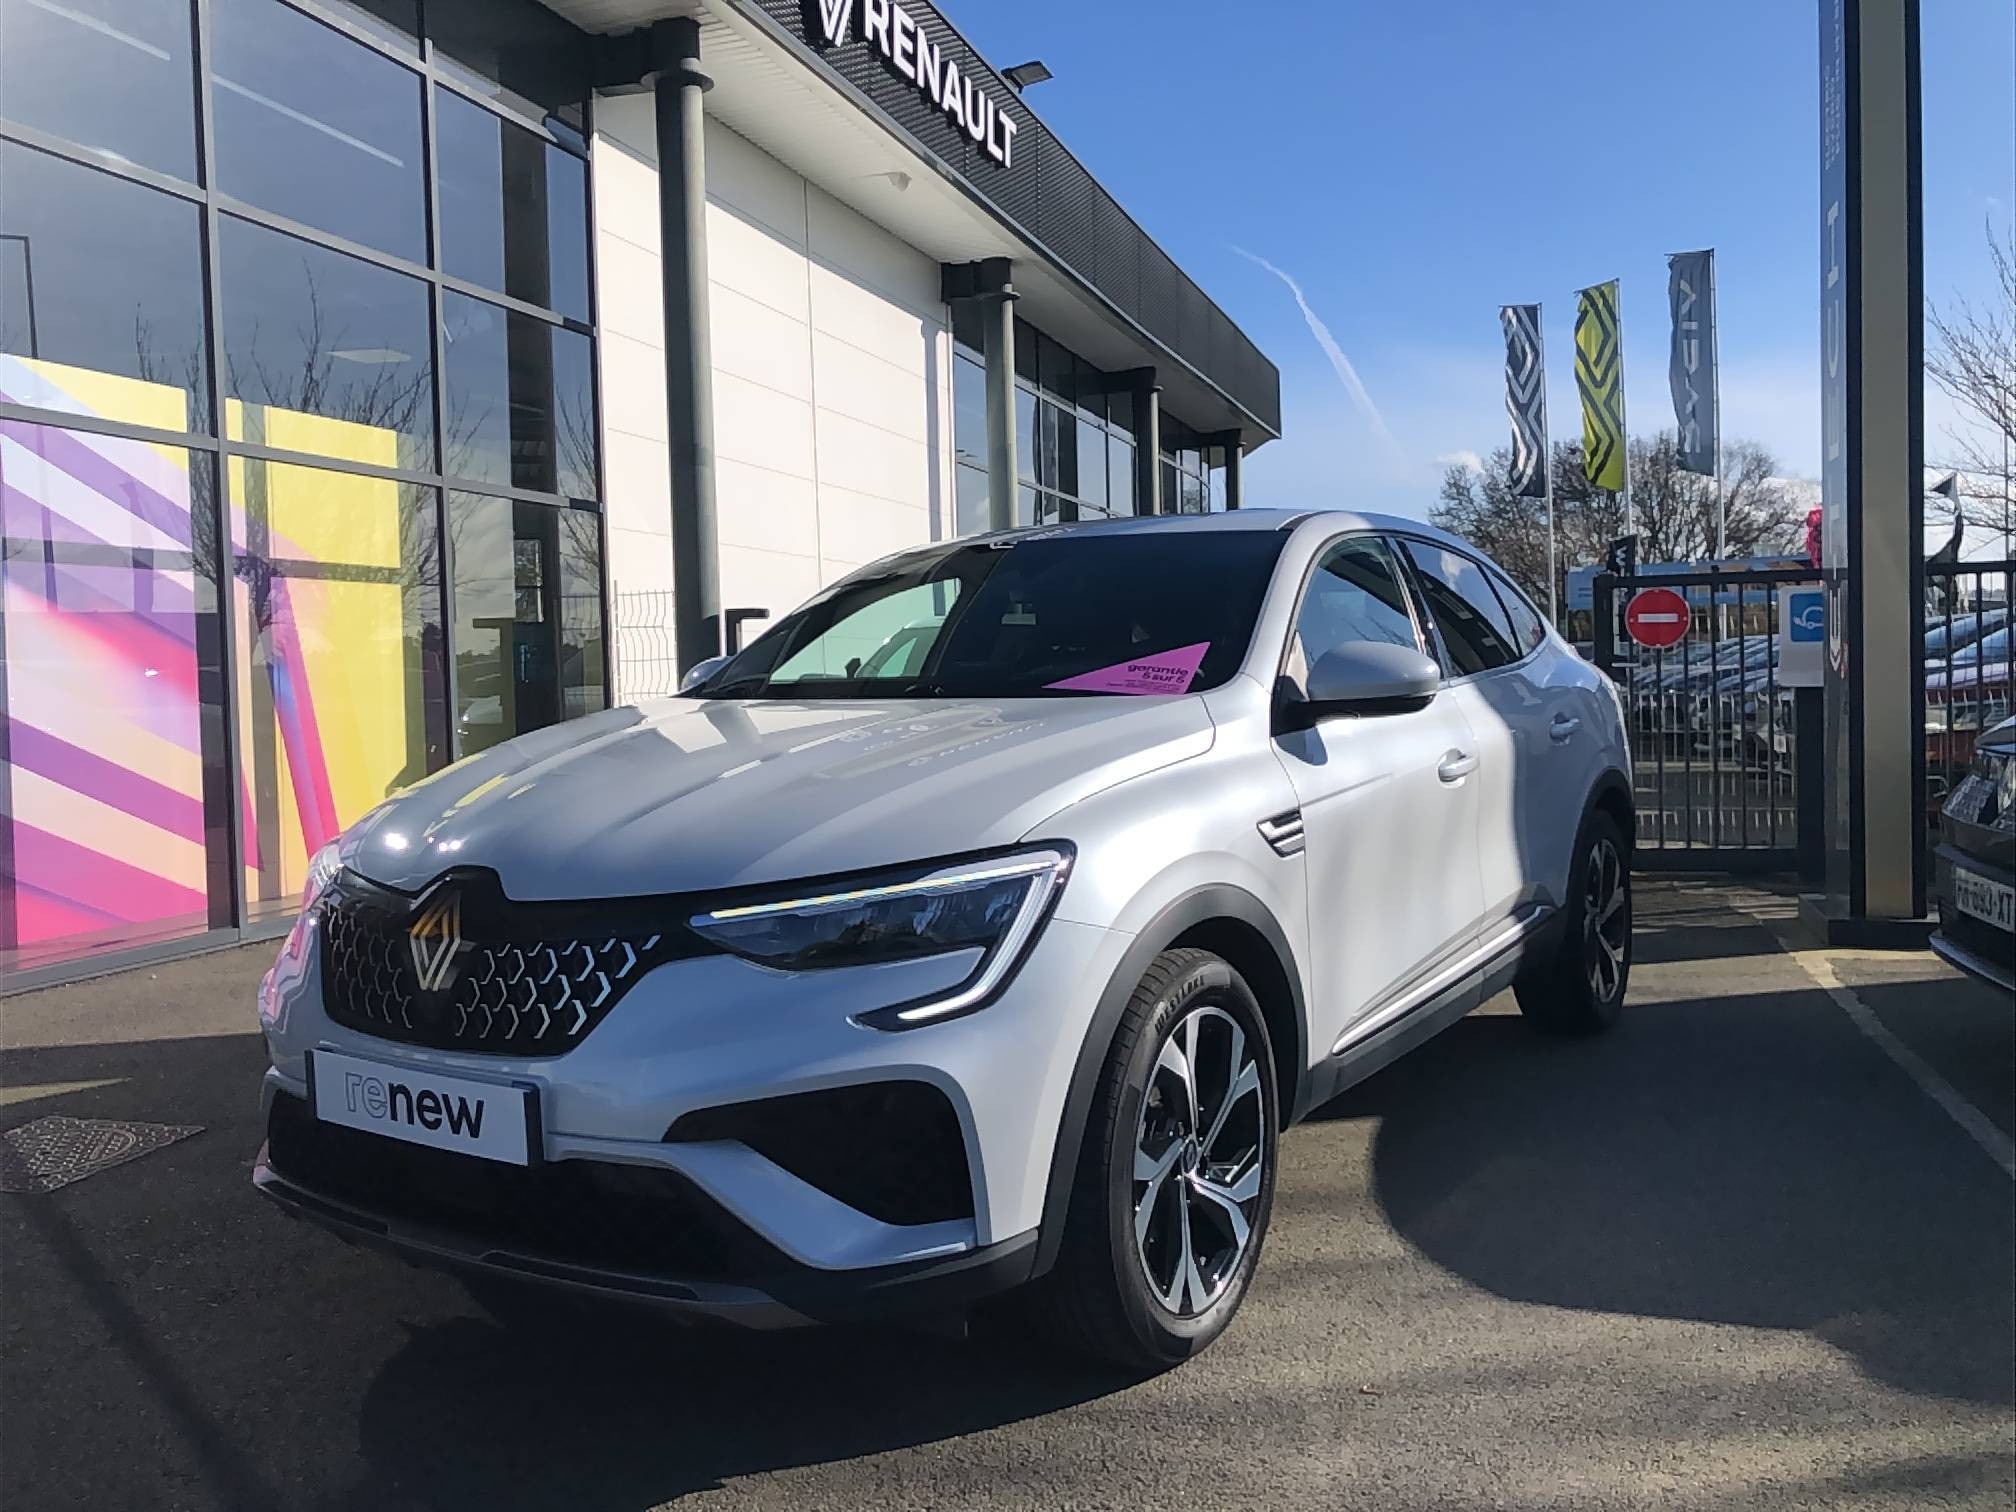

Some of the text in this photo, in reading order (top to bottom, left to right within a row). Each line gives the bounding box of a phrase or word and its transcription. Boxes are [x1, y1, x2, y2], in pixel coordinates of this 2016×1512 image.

[865, 0, 1017, 168] RENAULT
[1127, 664, 1189, 676] garantie
[1142, 671, 1186, 684] 5 sur 5
[344, 1071, 485, 1139] renew
